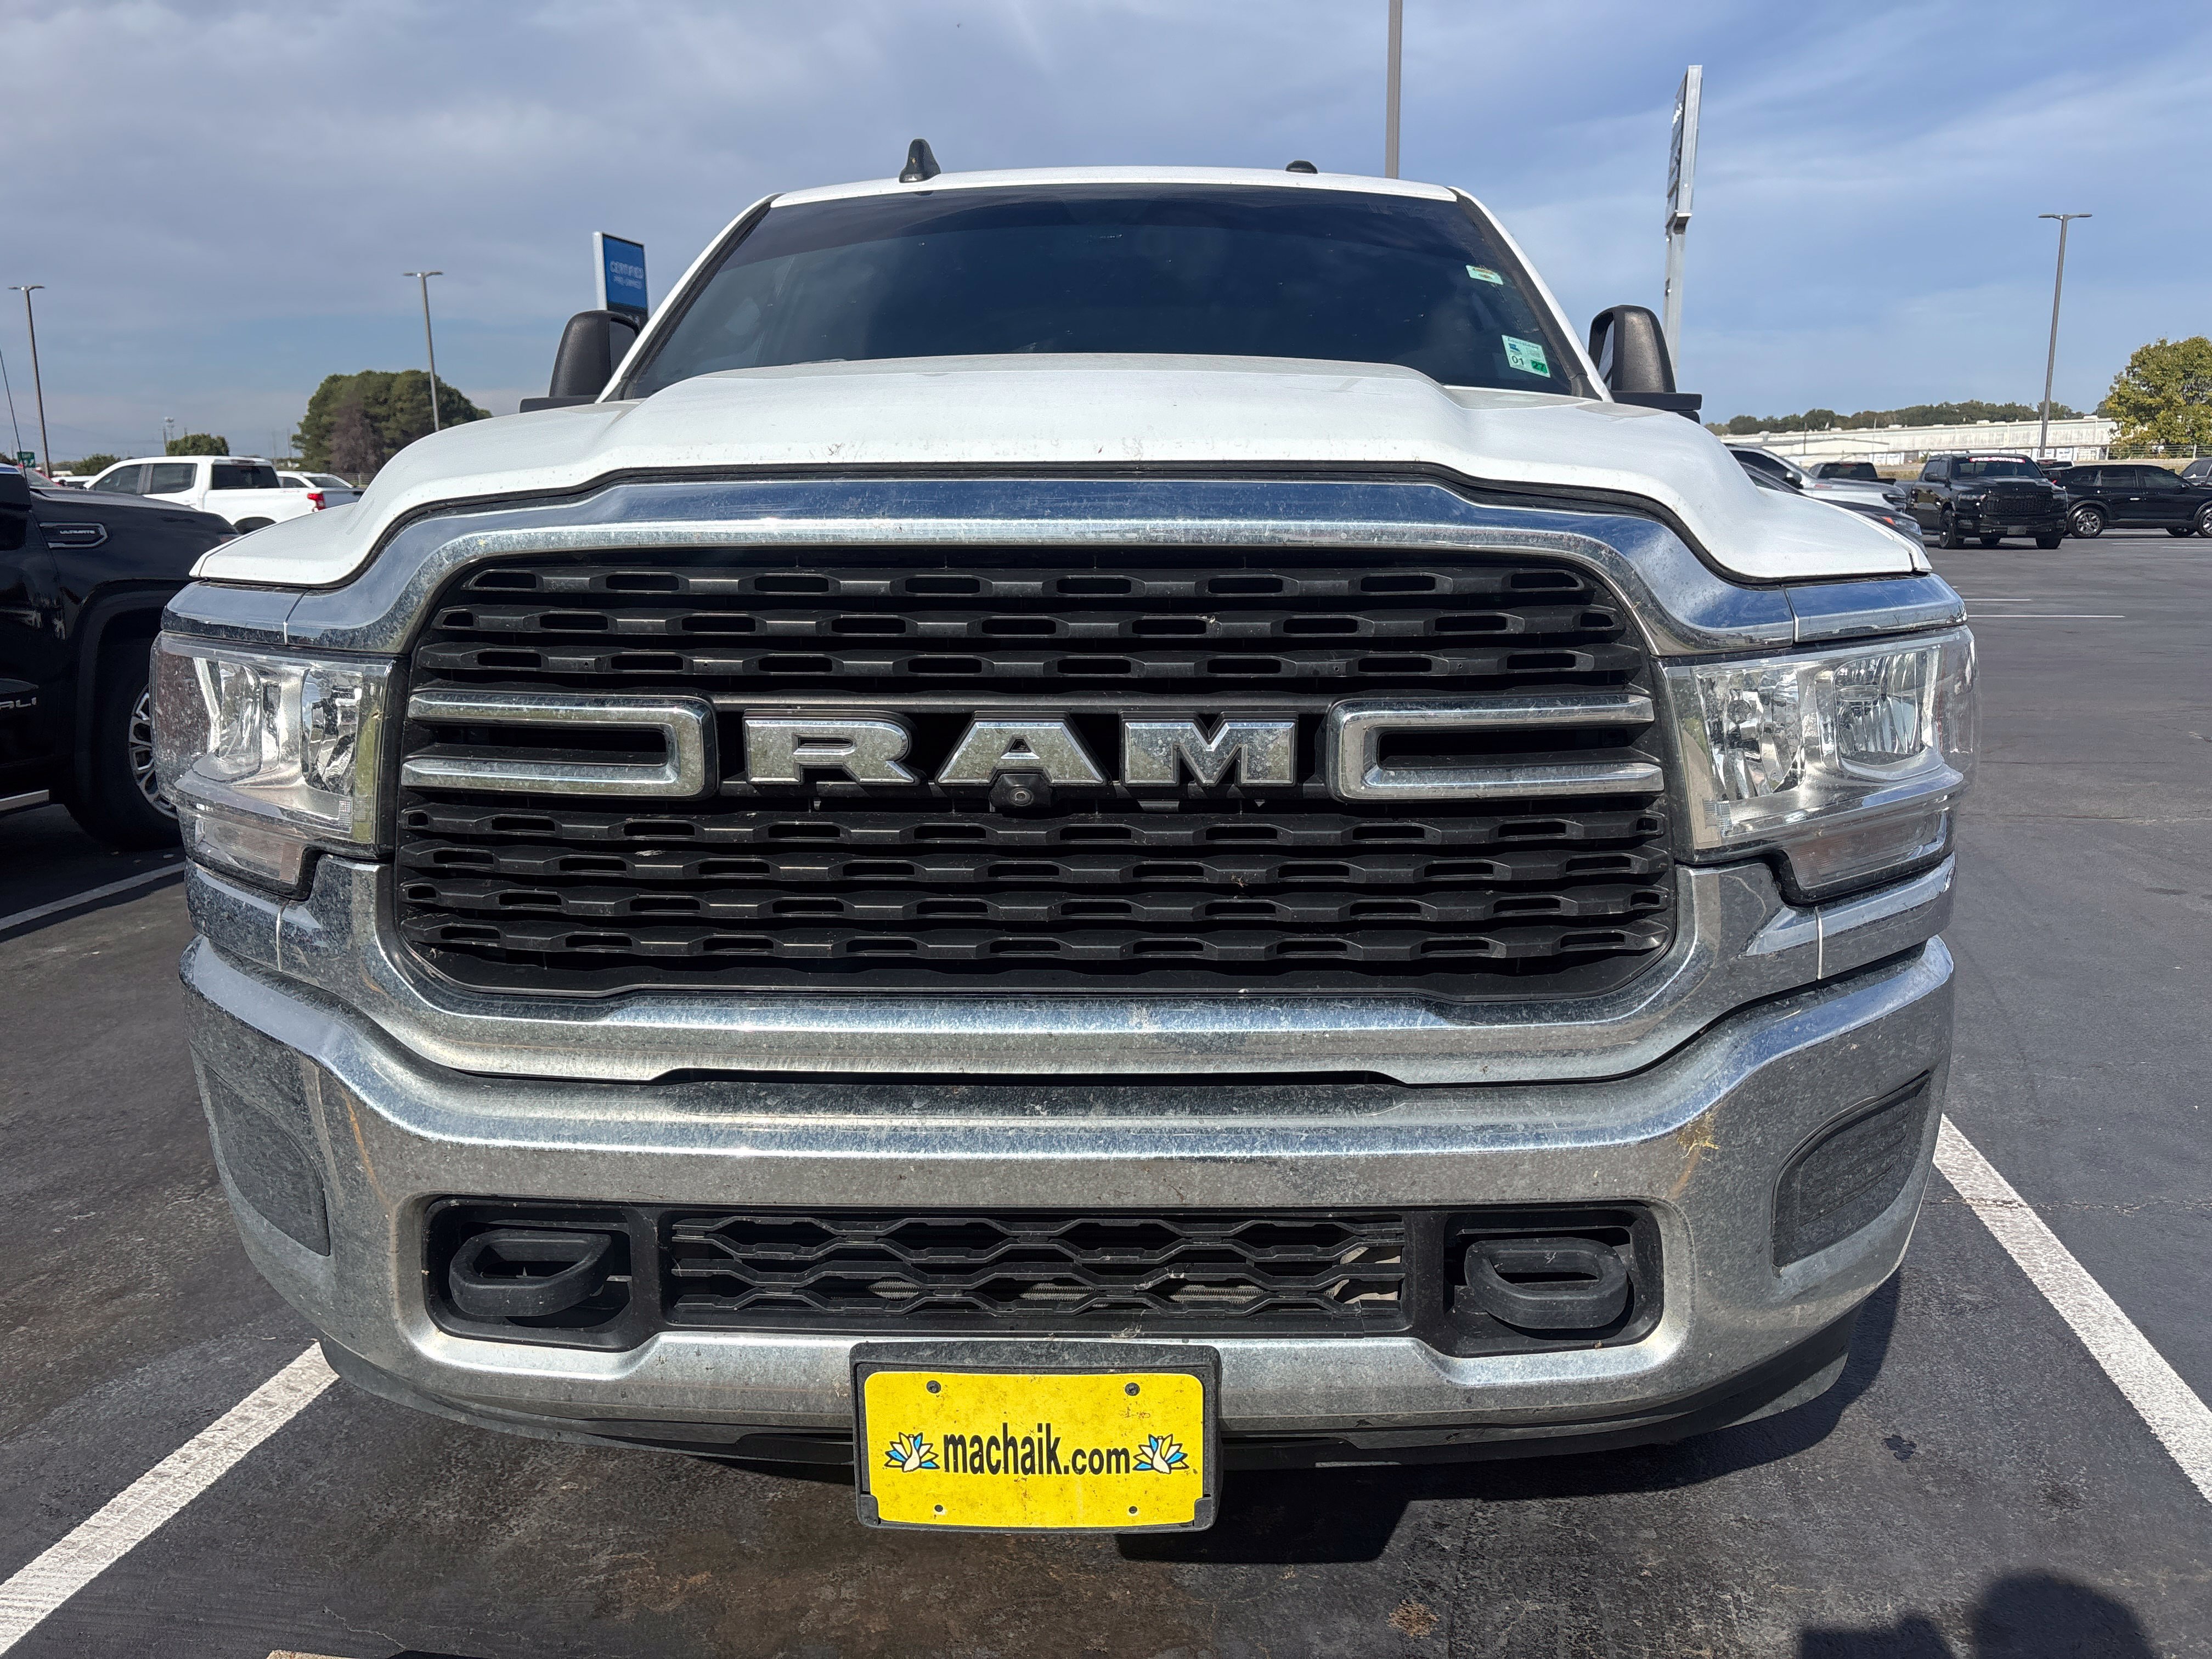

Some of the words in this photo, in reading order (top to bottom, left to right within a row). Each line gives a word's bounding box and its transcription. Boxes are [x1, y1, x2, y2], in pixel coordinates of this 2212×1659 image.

[1511, 356, 1524, 366] 01
[744, 711, 1299, 786] RAM
[943, 1422, 1130, 1475] machaik.com
